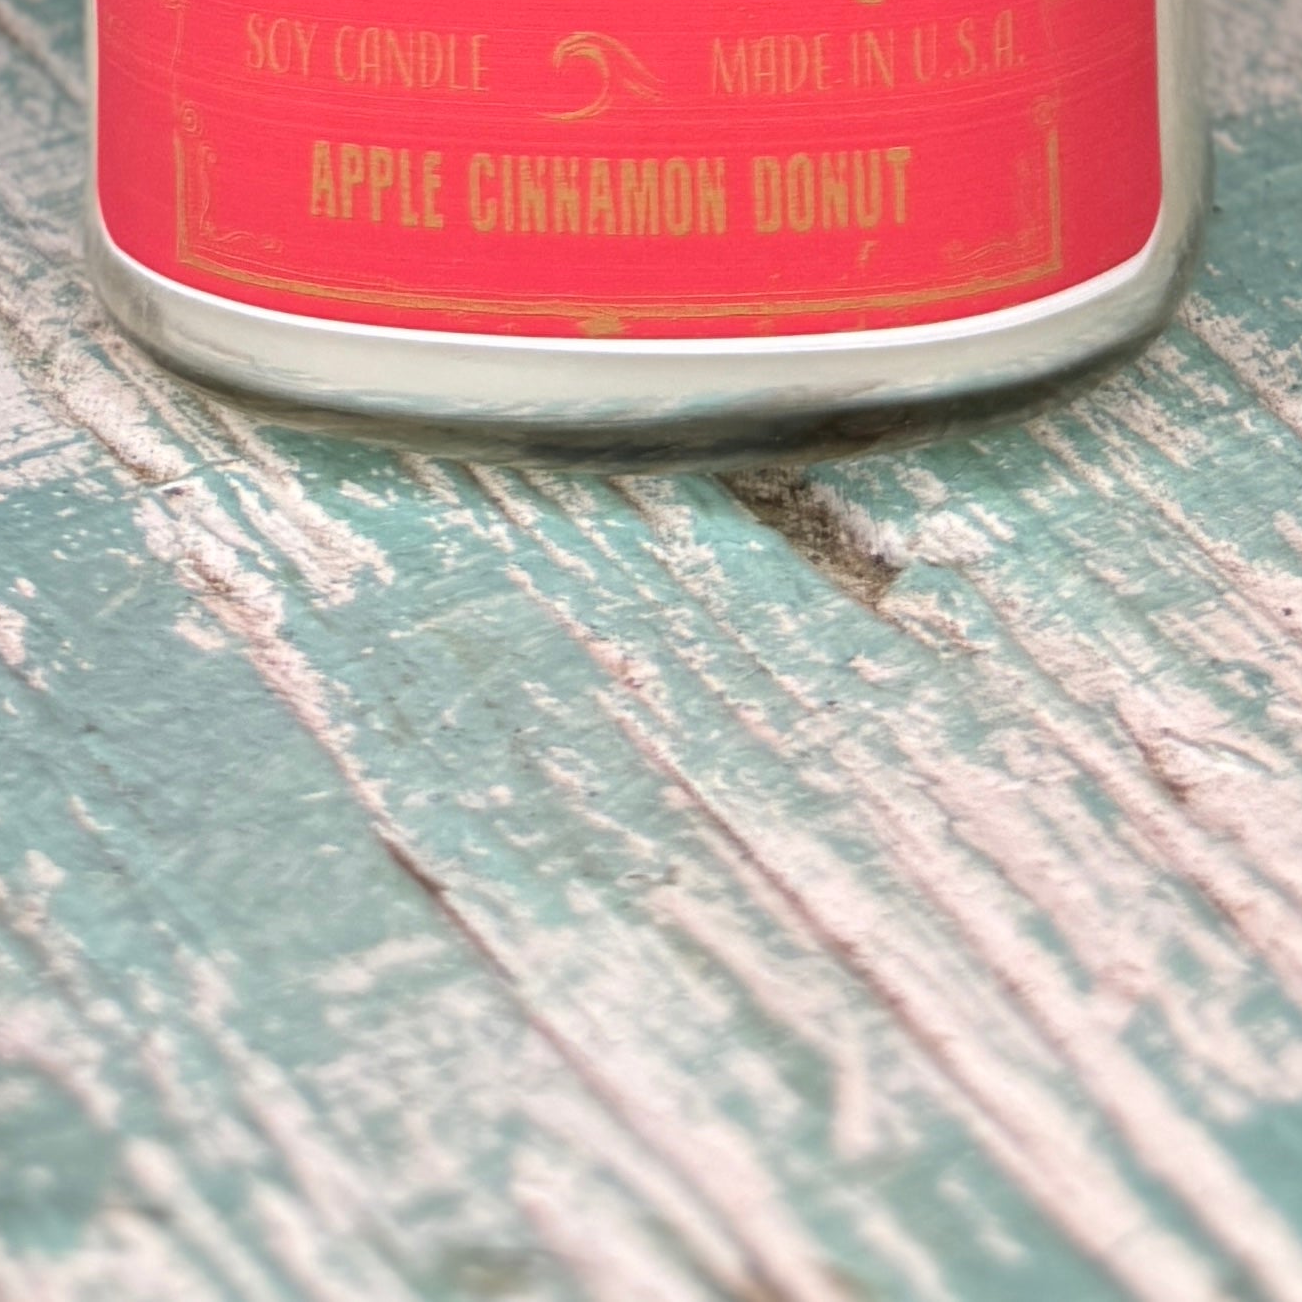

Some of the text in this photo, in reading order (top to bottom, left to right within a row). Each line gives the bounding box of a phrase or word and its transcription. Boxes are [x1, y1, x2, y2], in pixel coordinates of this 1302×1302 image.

[247, 12, 490, 92] SOY CANDLE
[711, 9, 1026, 95] MADE IN U.S.A.
[310, 140, 912, 237] APPLE CINNAMON DONUT
